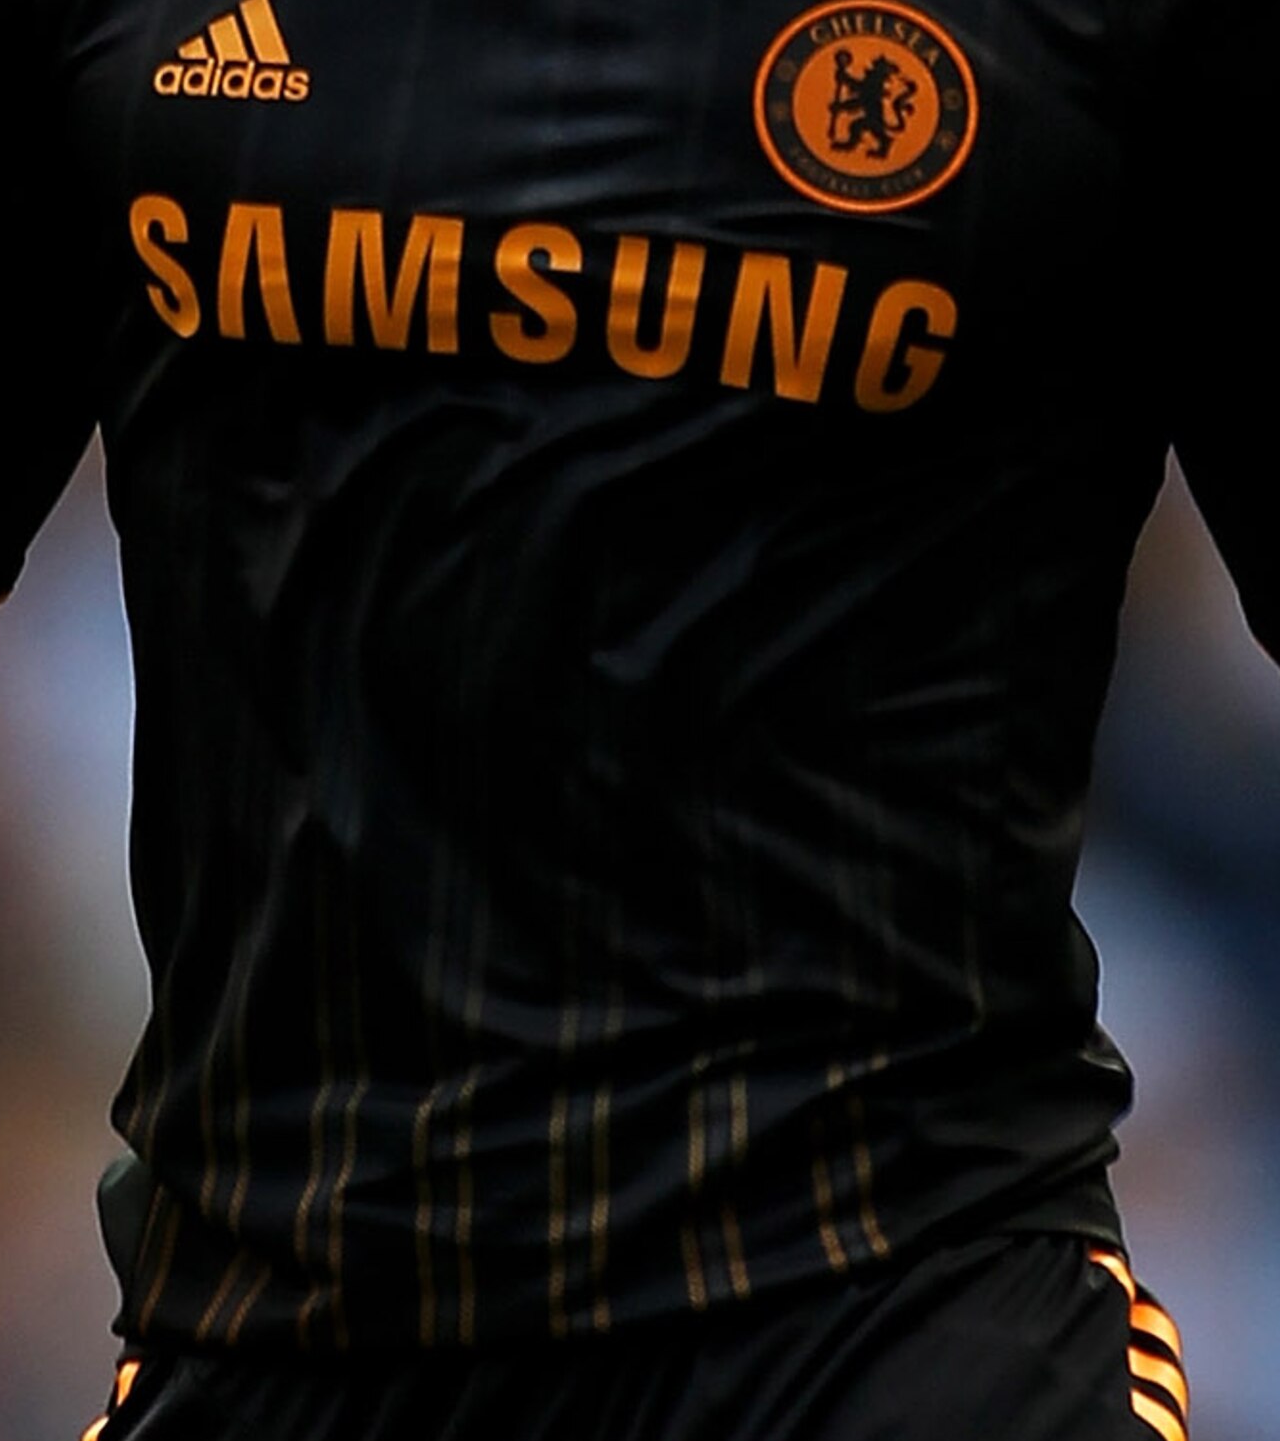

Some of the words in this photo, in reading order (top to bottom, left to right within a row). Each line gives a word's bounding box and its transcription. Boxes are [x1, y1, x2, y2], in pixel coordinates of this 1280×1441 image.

[809, 12, 942, 67] CHELSEA
[153, 58, 311, 103] adidas
[128, 194, 960, 414] SAMSUNG
